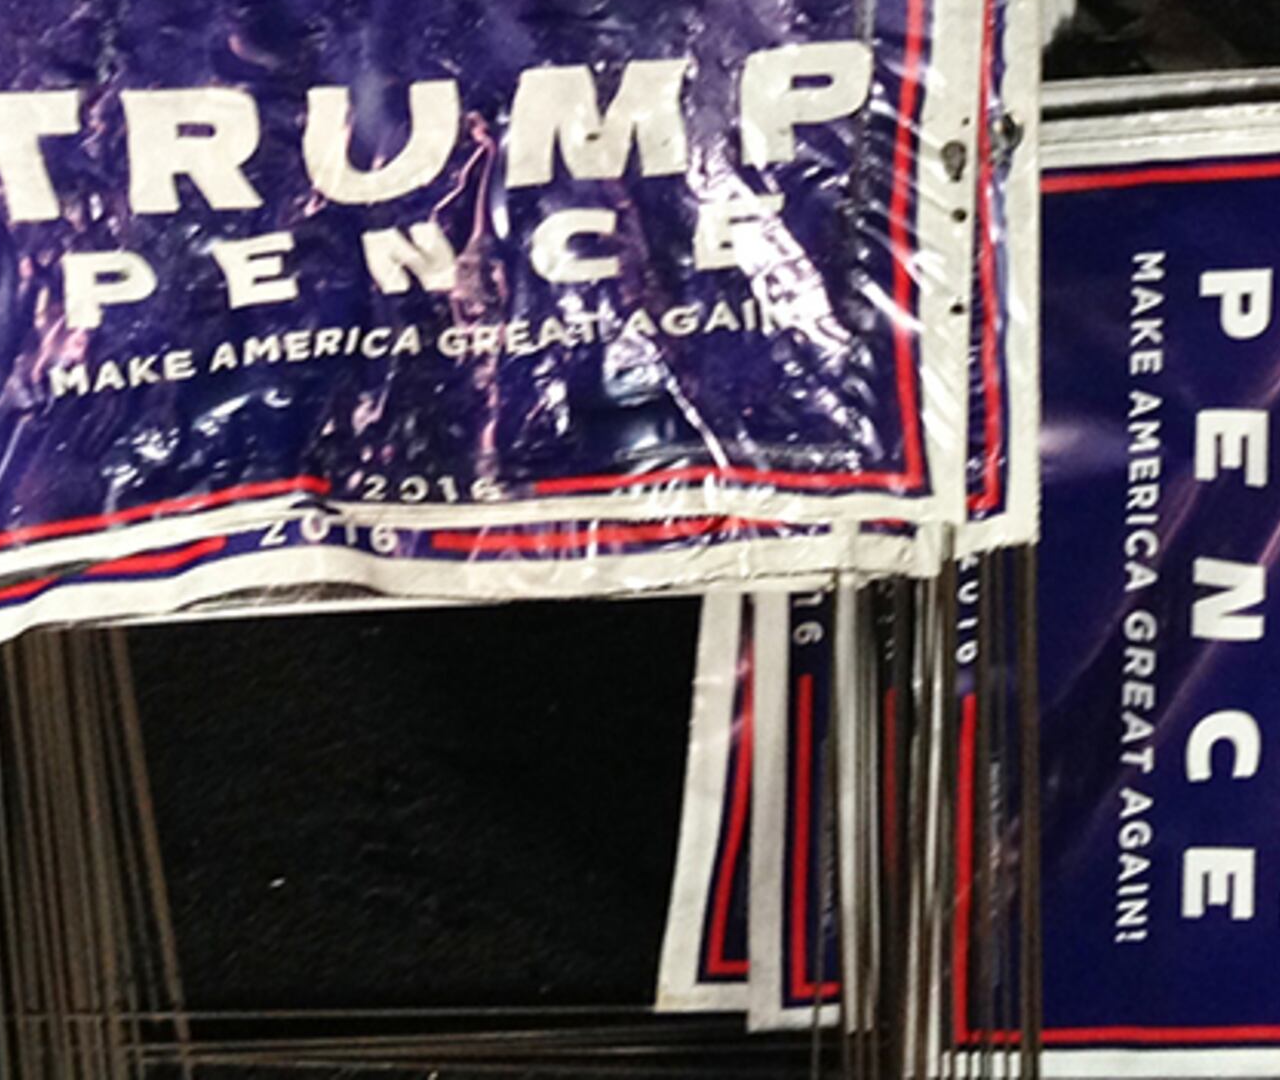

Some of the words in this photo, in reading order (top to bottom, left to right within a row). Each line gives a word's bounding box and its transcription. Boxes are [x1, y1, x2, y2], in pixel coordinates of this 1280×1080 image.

[61, 190, 786, 329] PENCE
[1127, 249, 1168, 376] MAKE
[49, 348, 197, 398] MAKE
[209, 328, 422, 375] AMERICA
[437, 312, 600, 359] GREAT
[259, 510, 399, 553] 2016
[362, 473, 503, 504] 2016
[1123, 388, 1163, 593] AMERICA
[1180, 268, 1275, 922] PENCE
[1119, 610, 1158, 775] GREAT
[1113, 786, 1155, 944] AGAIN!
